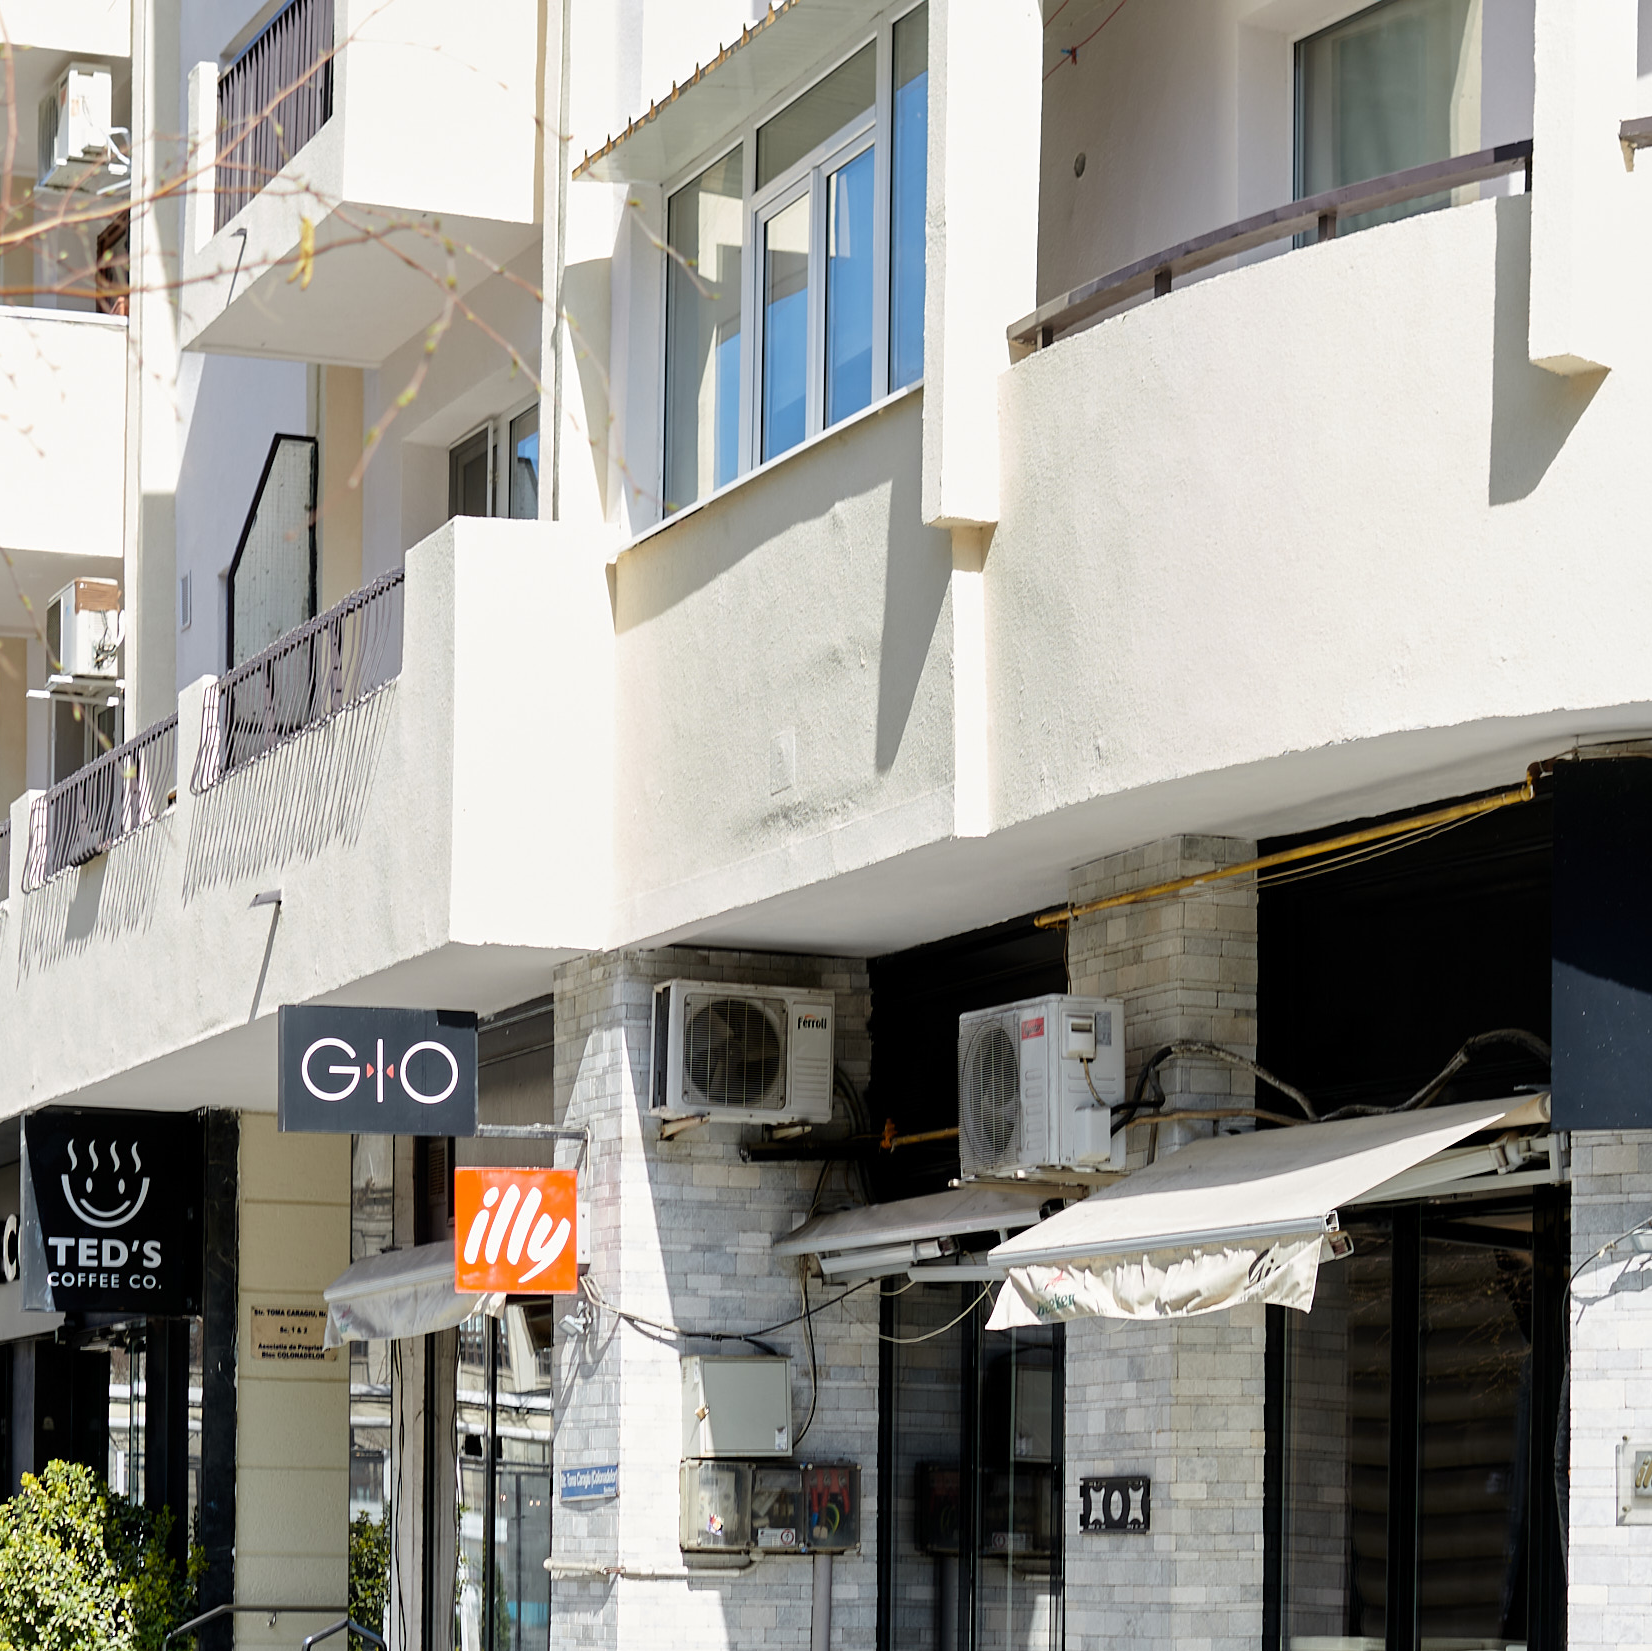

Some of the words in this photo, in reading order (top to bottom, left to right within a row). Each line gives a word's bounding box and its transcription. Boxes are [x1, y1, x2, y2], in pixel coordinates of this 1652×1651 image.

[301, 1037, 460, 1104] GIO
[2, 1213, 21, 1283] C
[48, 1236, 162, 1269] TED'S
[463, 1183, 572, 1284] illy
[46, 1271, 120, 1289] COFFEE
[129, 1274, 162, 1290] CO.
[267, 1309, 285, 1317] TOMA
[286, 1309, 318, 1318] CARAGIU,
